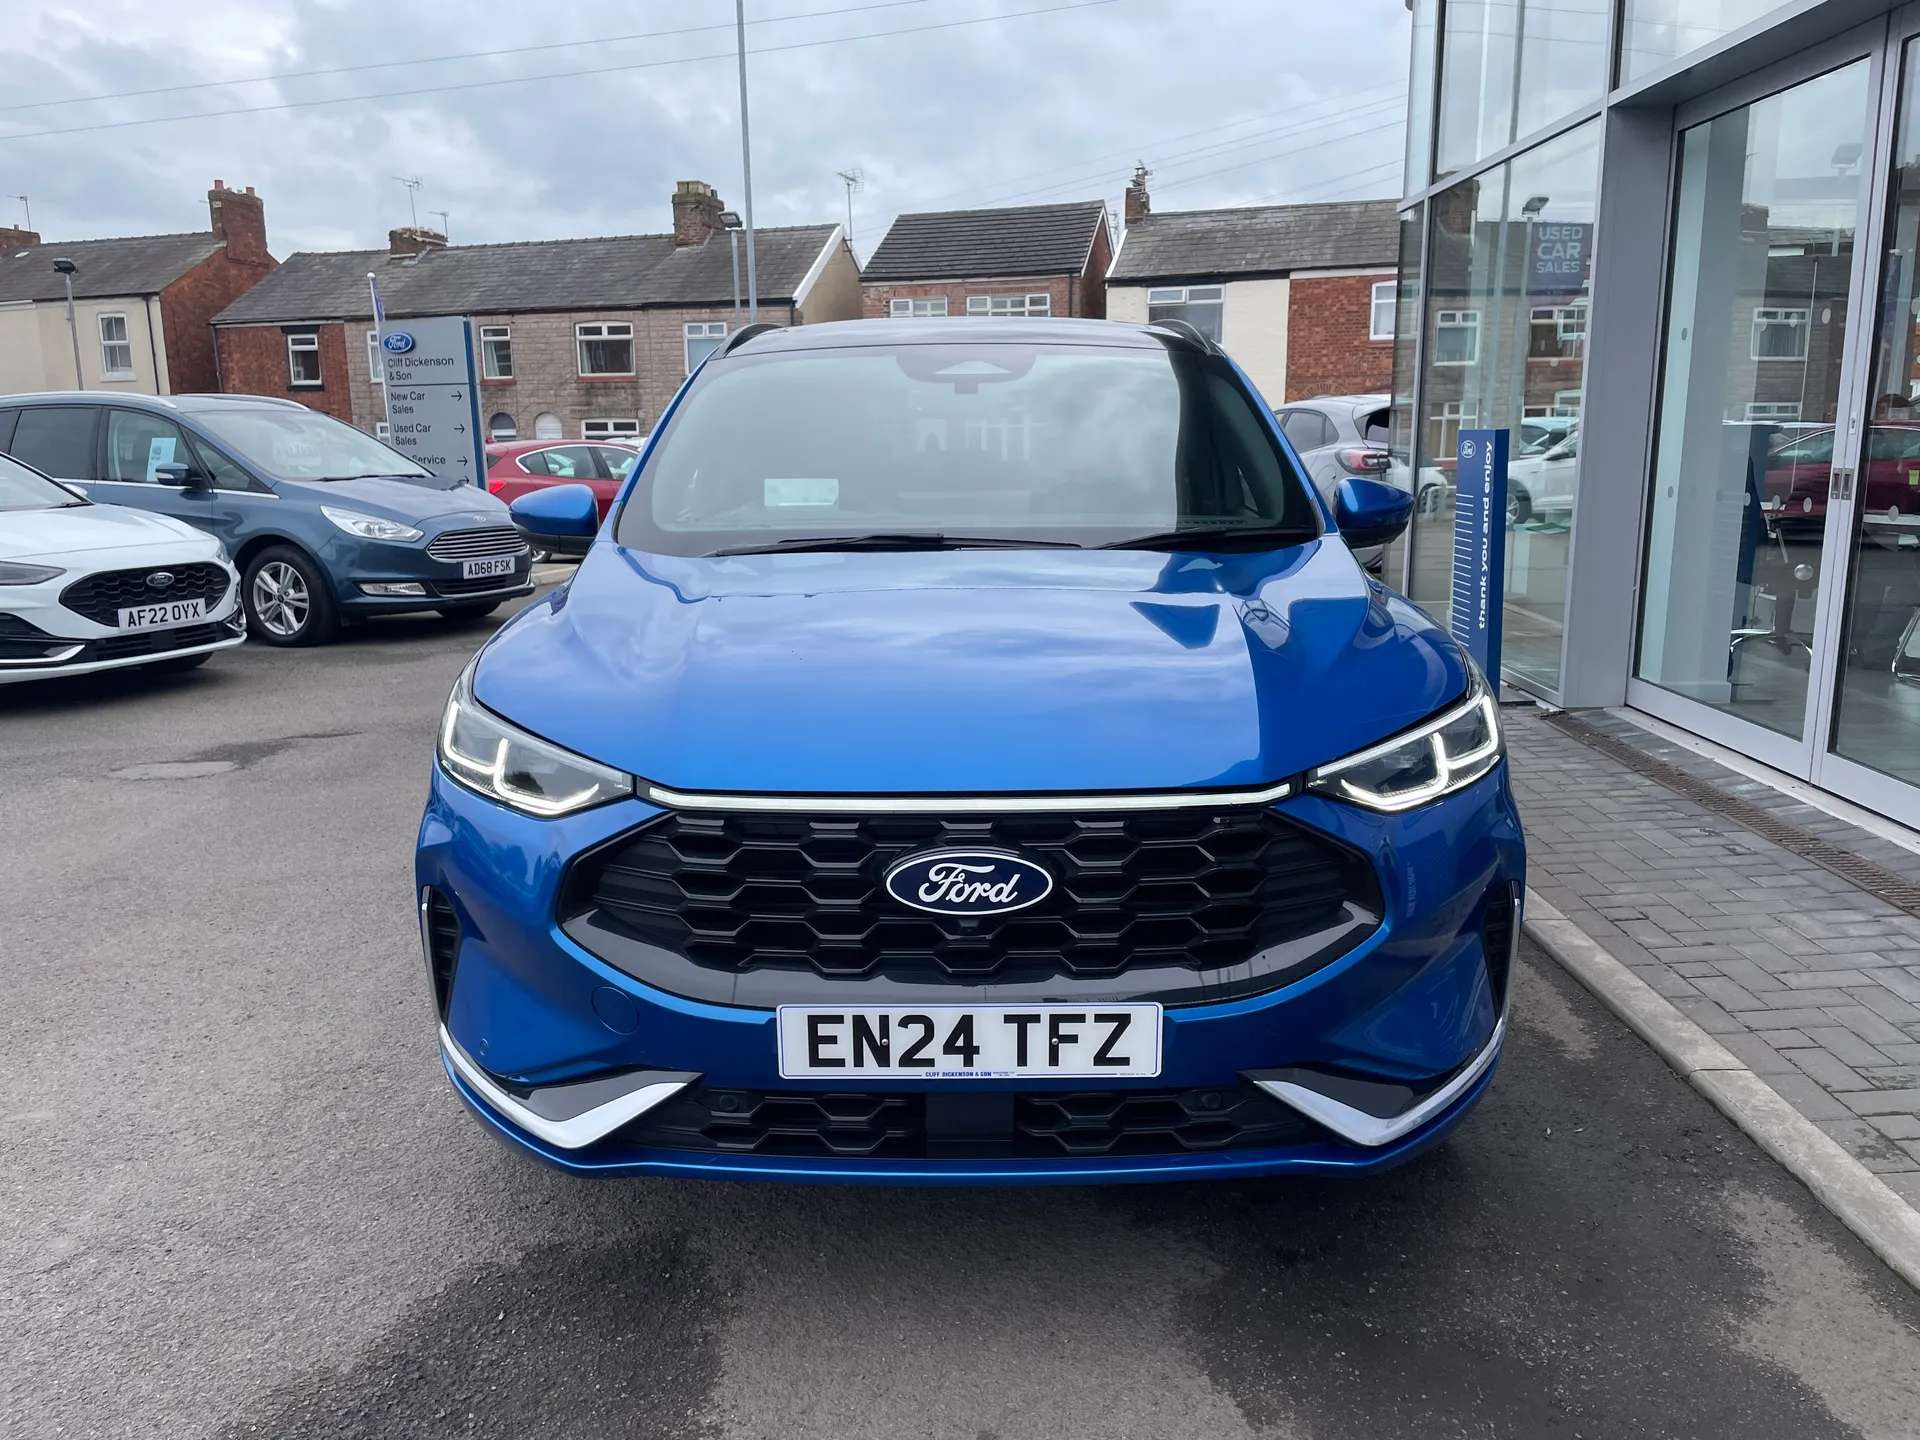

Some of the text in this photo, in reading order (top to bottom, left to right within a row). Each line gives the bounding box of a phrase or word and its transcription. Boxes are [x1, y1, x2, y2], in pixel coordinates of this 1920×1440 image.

[1539, 226, 1583, 240] USED
[1537, 242, 1582, 259] CAR
[1536, 261, 1580, 273] SALES
[388, 356, 454, 368] Cliff Dickenson
[389, 370, 412, 381] & Son
[391, 391, 425, 401] New Car
[392, 404, 414, 414] Sales
[394, 423, 431, 433] Used Car
[395, 436, 417, 446] Sales
[1478, 440, 1493, 630] thank you and enjoy
[468, 559, 511, 576] AD68 FSK
[128, 601, 200, 628] AF22 OYX
[918, 862, 1021, 903] Ford
[807, 1013, 1132, 1068] EN24 TFZ
